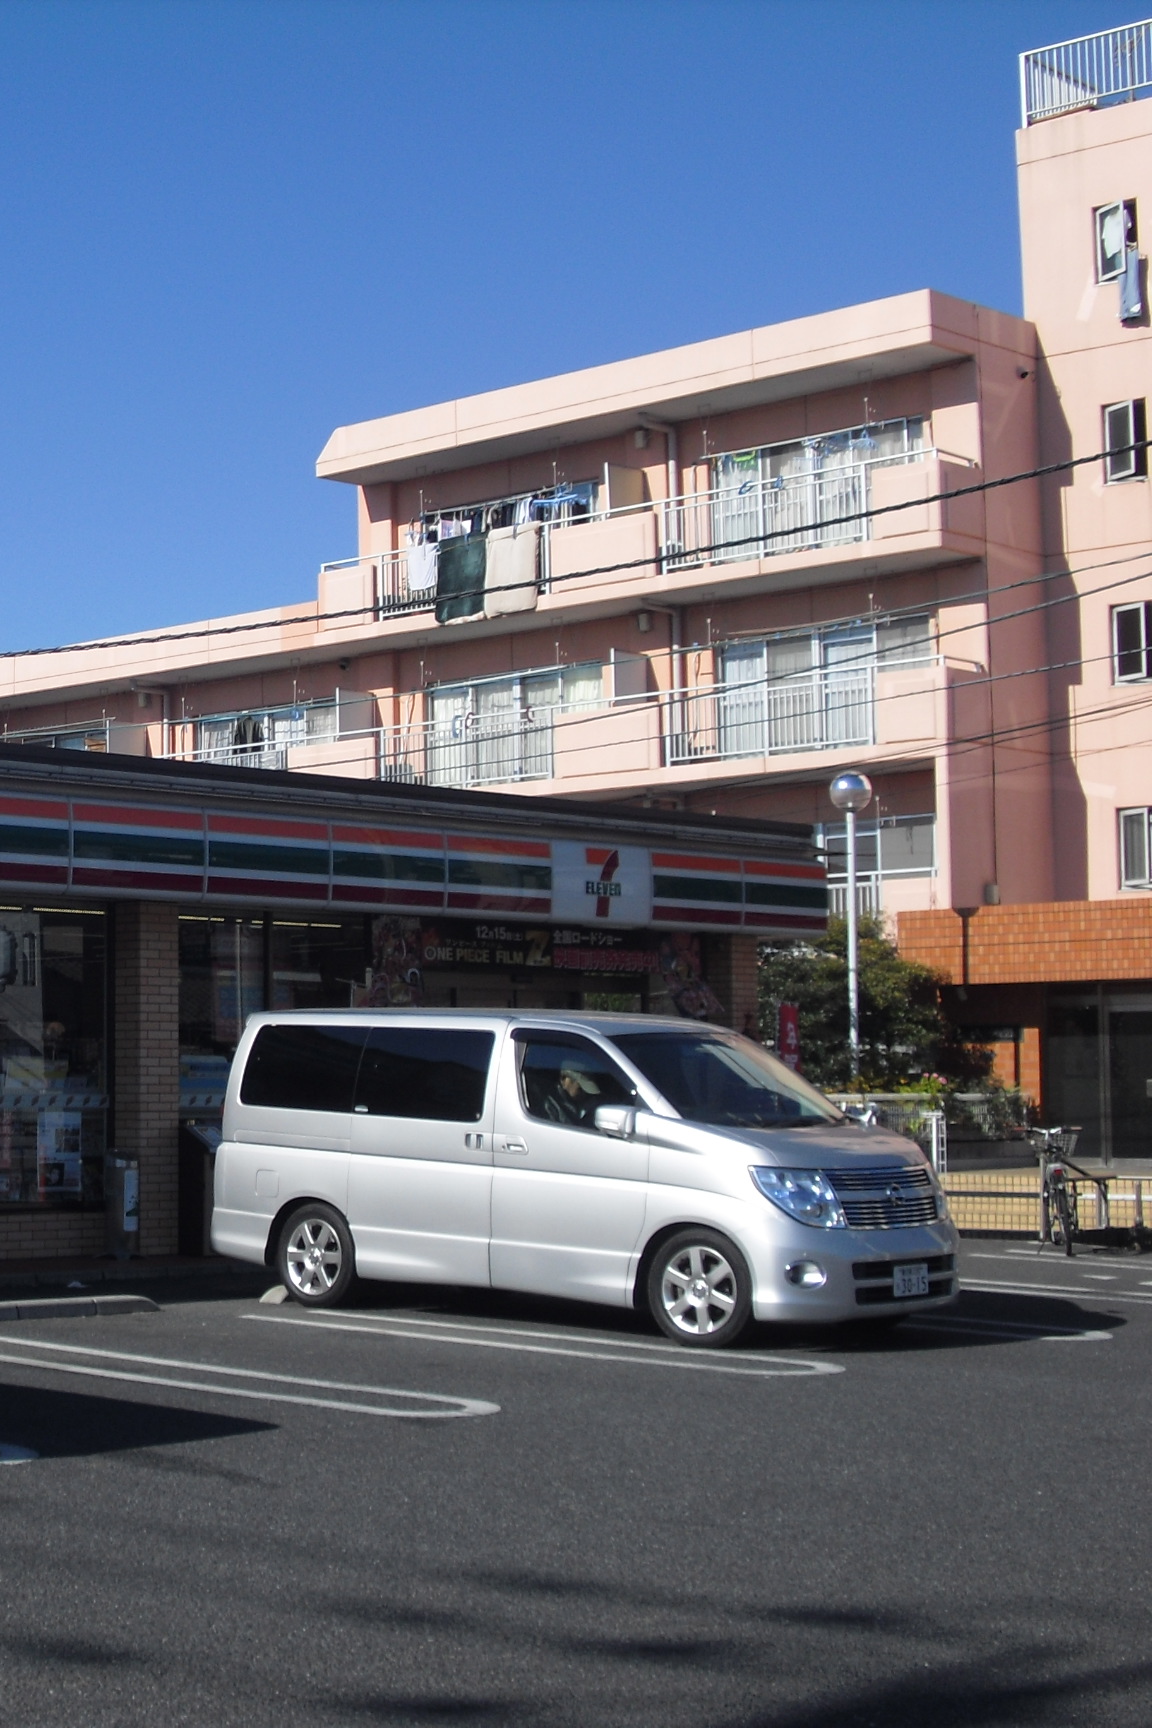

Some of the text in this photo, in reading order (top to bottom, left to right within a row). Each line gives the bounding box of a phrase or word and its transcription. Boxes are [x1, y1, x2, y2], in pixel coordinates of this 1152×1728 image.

[552, 929, 624, 947] 全国ロードショー
[424, 946, 454, 961] ONE
[456, 948, 490, 963] PIECE
[495, 950, 524, 965] FILM
